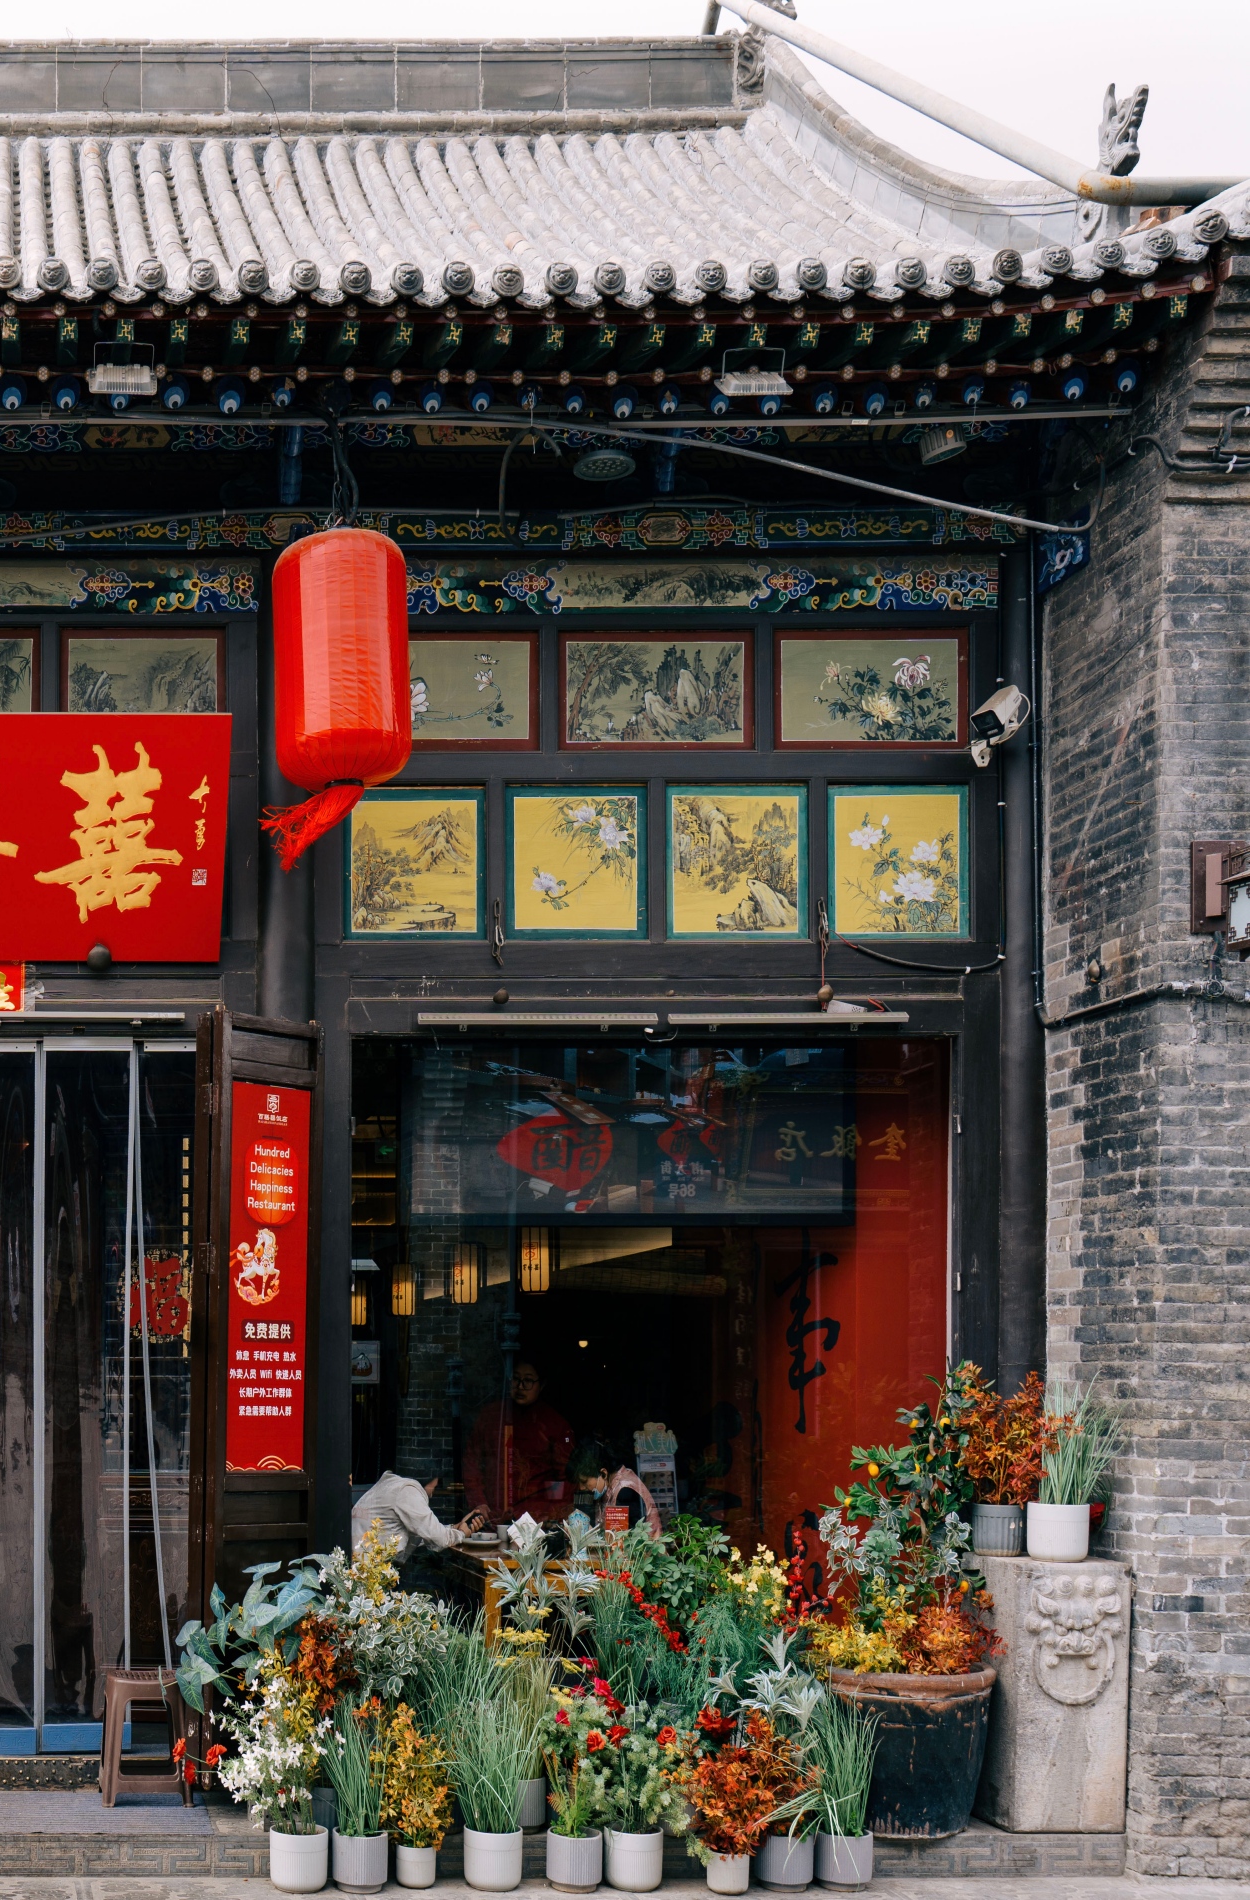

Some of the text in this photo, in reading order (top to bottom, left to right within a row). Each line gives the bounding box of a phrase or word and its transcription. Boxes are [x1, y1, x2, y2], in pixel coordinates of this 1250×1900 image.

[254, 1144, 290, 1159] Hundred
[250, 1161, 293, 1176] Delicacies
[250, 1179, 293, 1194] Happiness
[247, 1196, 295, 1211] Restaurant
[244, 1322, 291, 1339] 免费提供
[253, 1350, 280, 1361] 手机充电
[283, 1351, 296, 1362] 热水
[229, 1368, 257, 1379] 外卖人员
[276, 1369, 302, 1380] 快递人员
[239, 1387, 292, 1398] 长期户外工作群体
[238, 1405, 292, 1416] 紧急需要帮助人群
